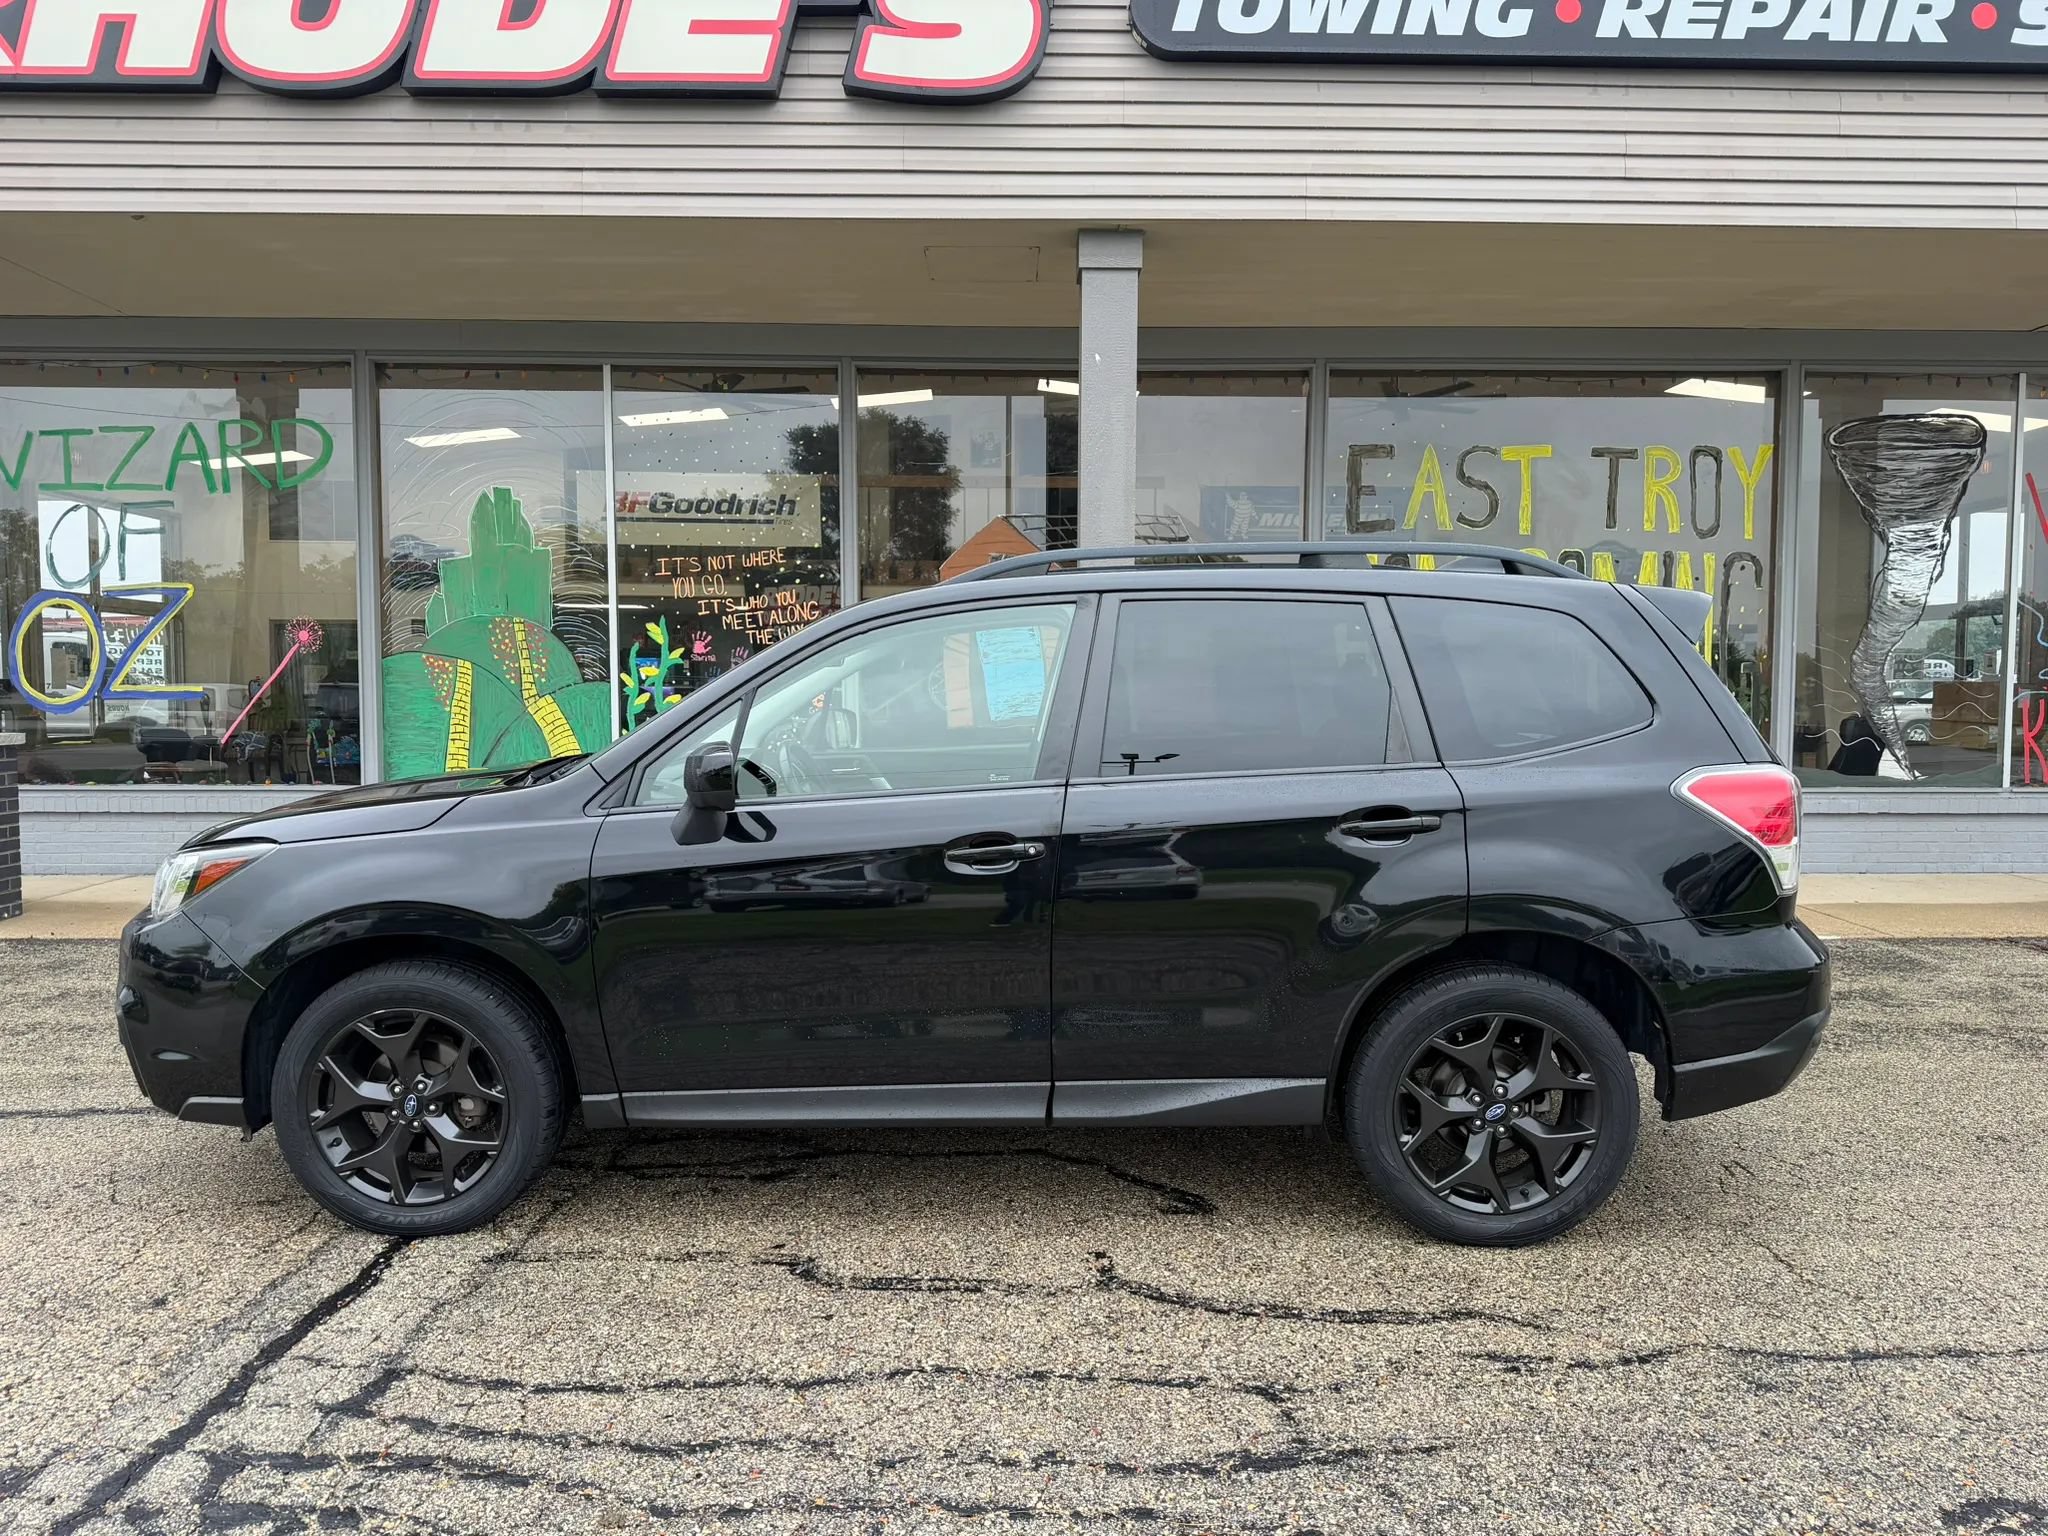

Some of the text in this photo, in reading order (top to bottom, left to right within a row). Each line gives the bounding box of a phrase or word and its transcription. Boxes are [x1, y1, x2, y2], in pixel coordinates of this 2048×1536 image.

[1346, 443, 1774, 540] EAST TROY
[46, 500, 174, 588] OF
[655, 547, 787, 576] IT'S NOT WHERE
[672, 576, 695, 599] YOU
[698, 589, 796, 616] IT'S WHO YOU
[722, 600, 819, 630] MEET ALONG
[8, 582, 205, 715] OZ
[745, 628, 775, 645] THE
